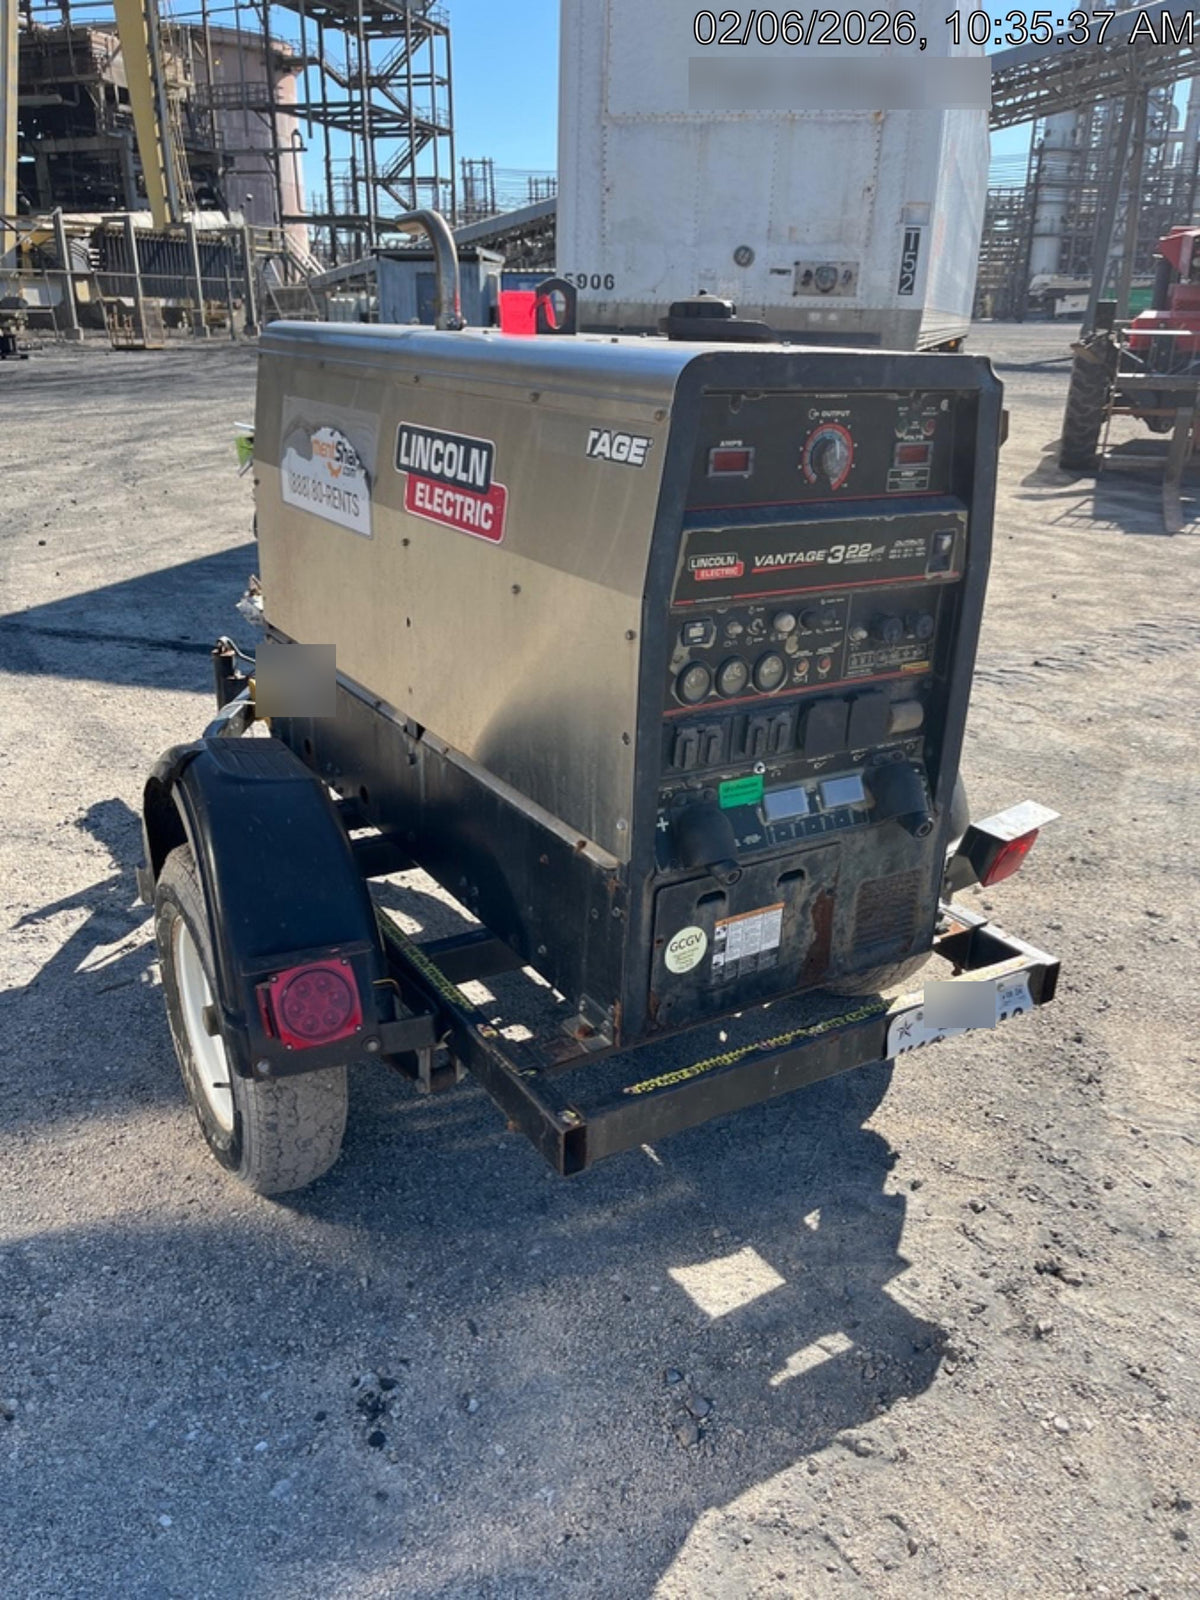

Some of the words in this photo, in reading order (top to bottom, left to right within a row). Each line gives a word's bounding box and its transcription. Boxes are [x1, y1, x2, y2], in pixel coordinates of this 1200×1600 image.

[400, 431, 488, 487] LINCOLN
[414, 481, 494, 531] ELECTRIC
[690, 555, 736, 568] LINCOLN
[754, 548, 828, 567] VANTAGE
[827, 543, 872, 565] 322
[669, 932, 703, 953] GCGV
